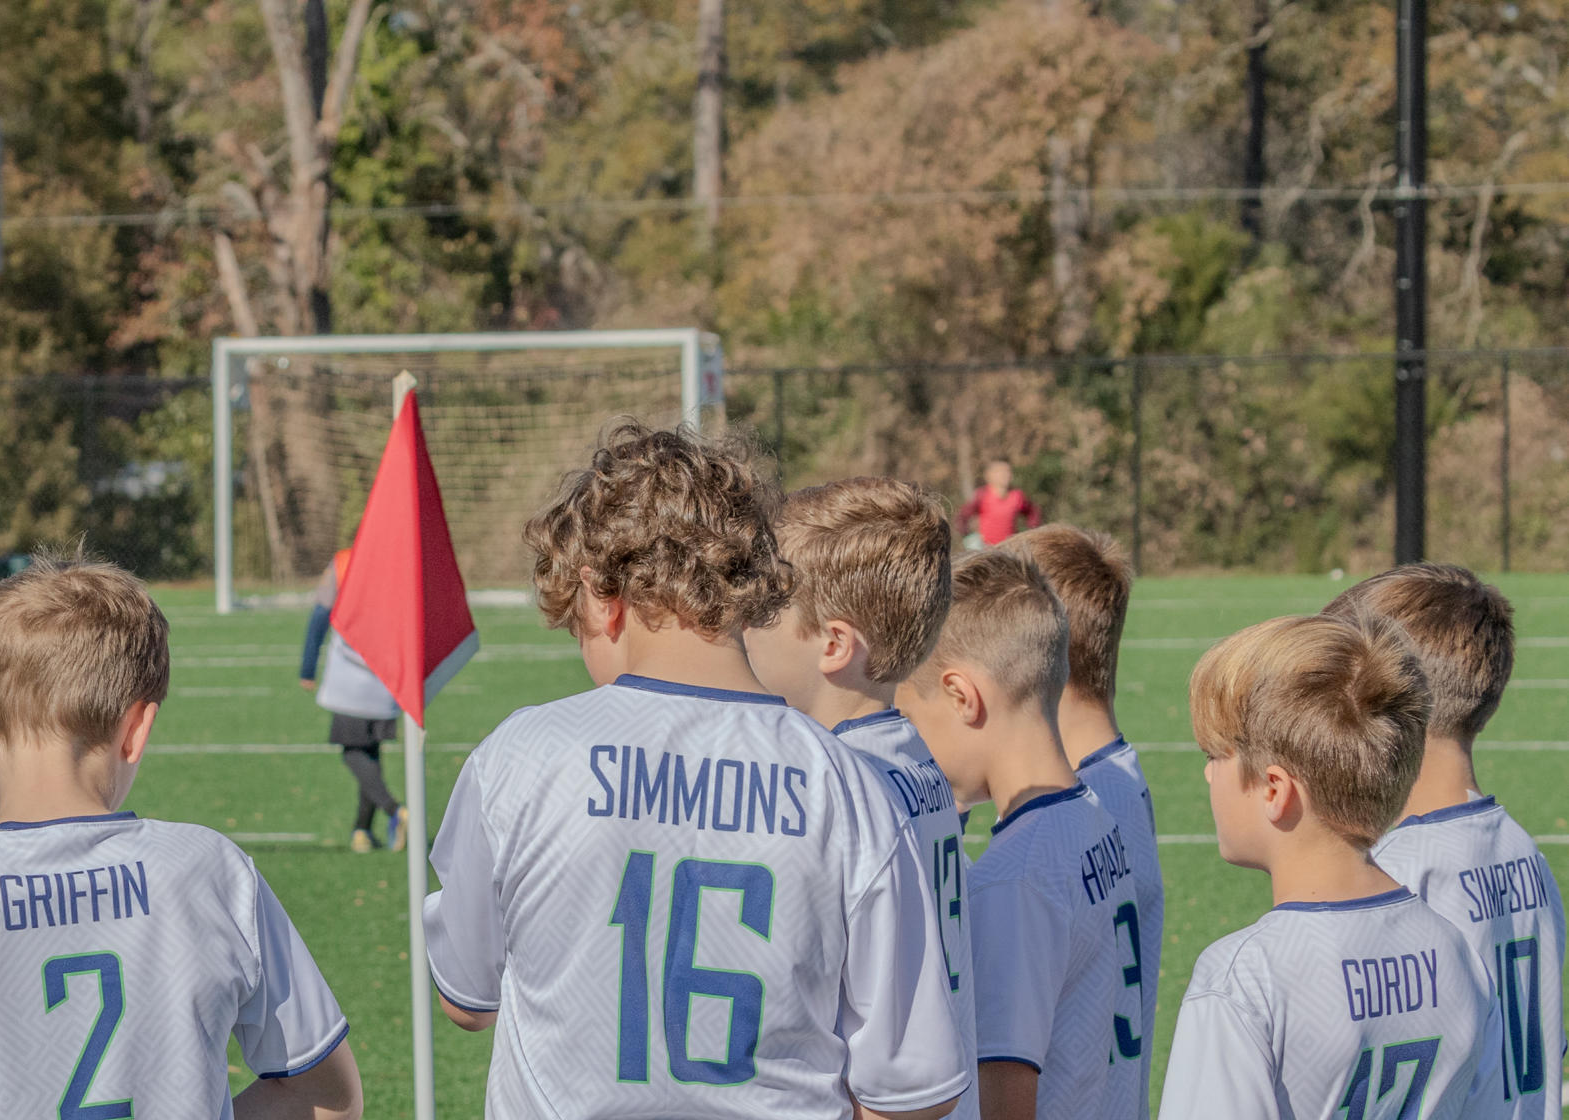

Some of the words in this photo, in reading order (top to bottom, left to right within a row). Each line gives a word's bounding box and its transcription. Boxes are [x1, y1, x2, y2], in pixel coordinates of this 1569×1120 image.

[587, 744, 807, 837] SIMMONS
[1458, 853, 1549, 923] SIMPSON
[607, 849, 777, 1087] 16
[1341, 948, 1438, 1022] GORDY
[1495, 935, 1546, 1103] 10
